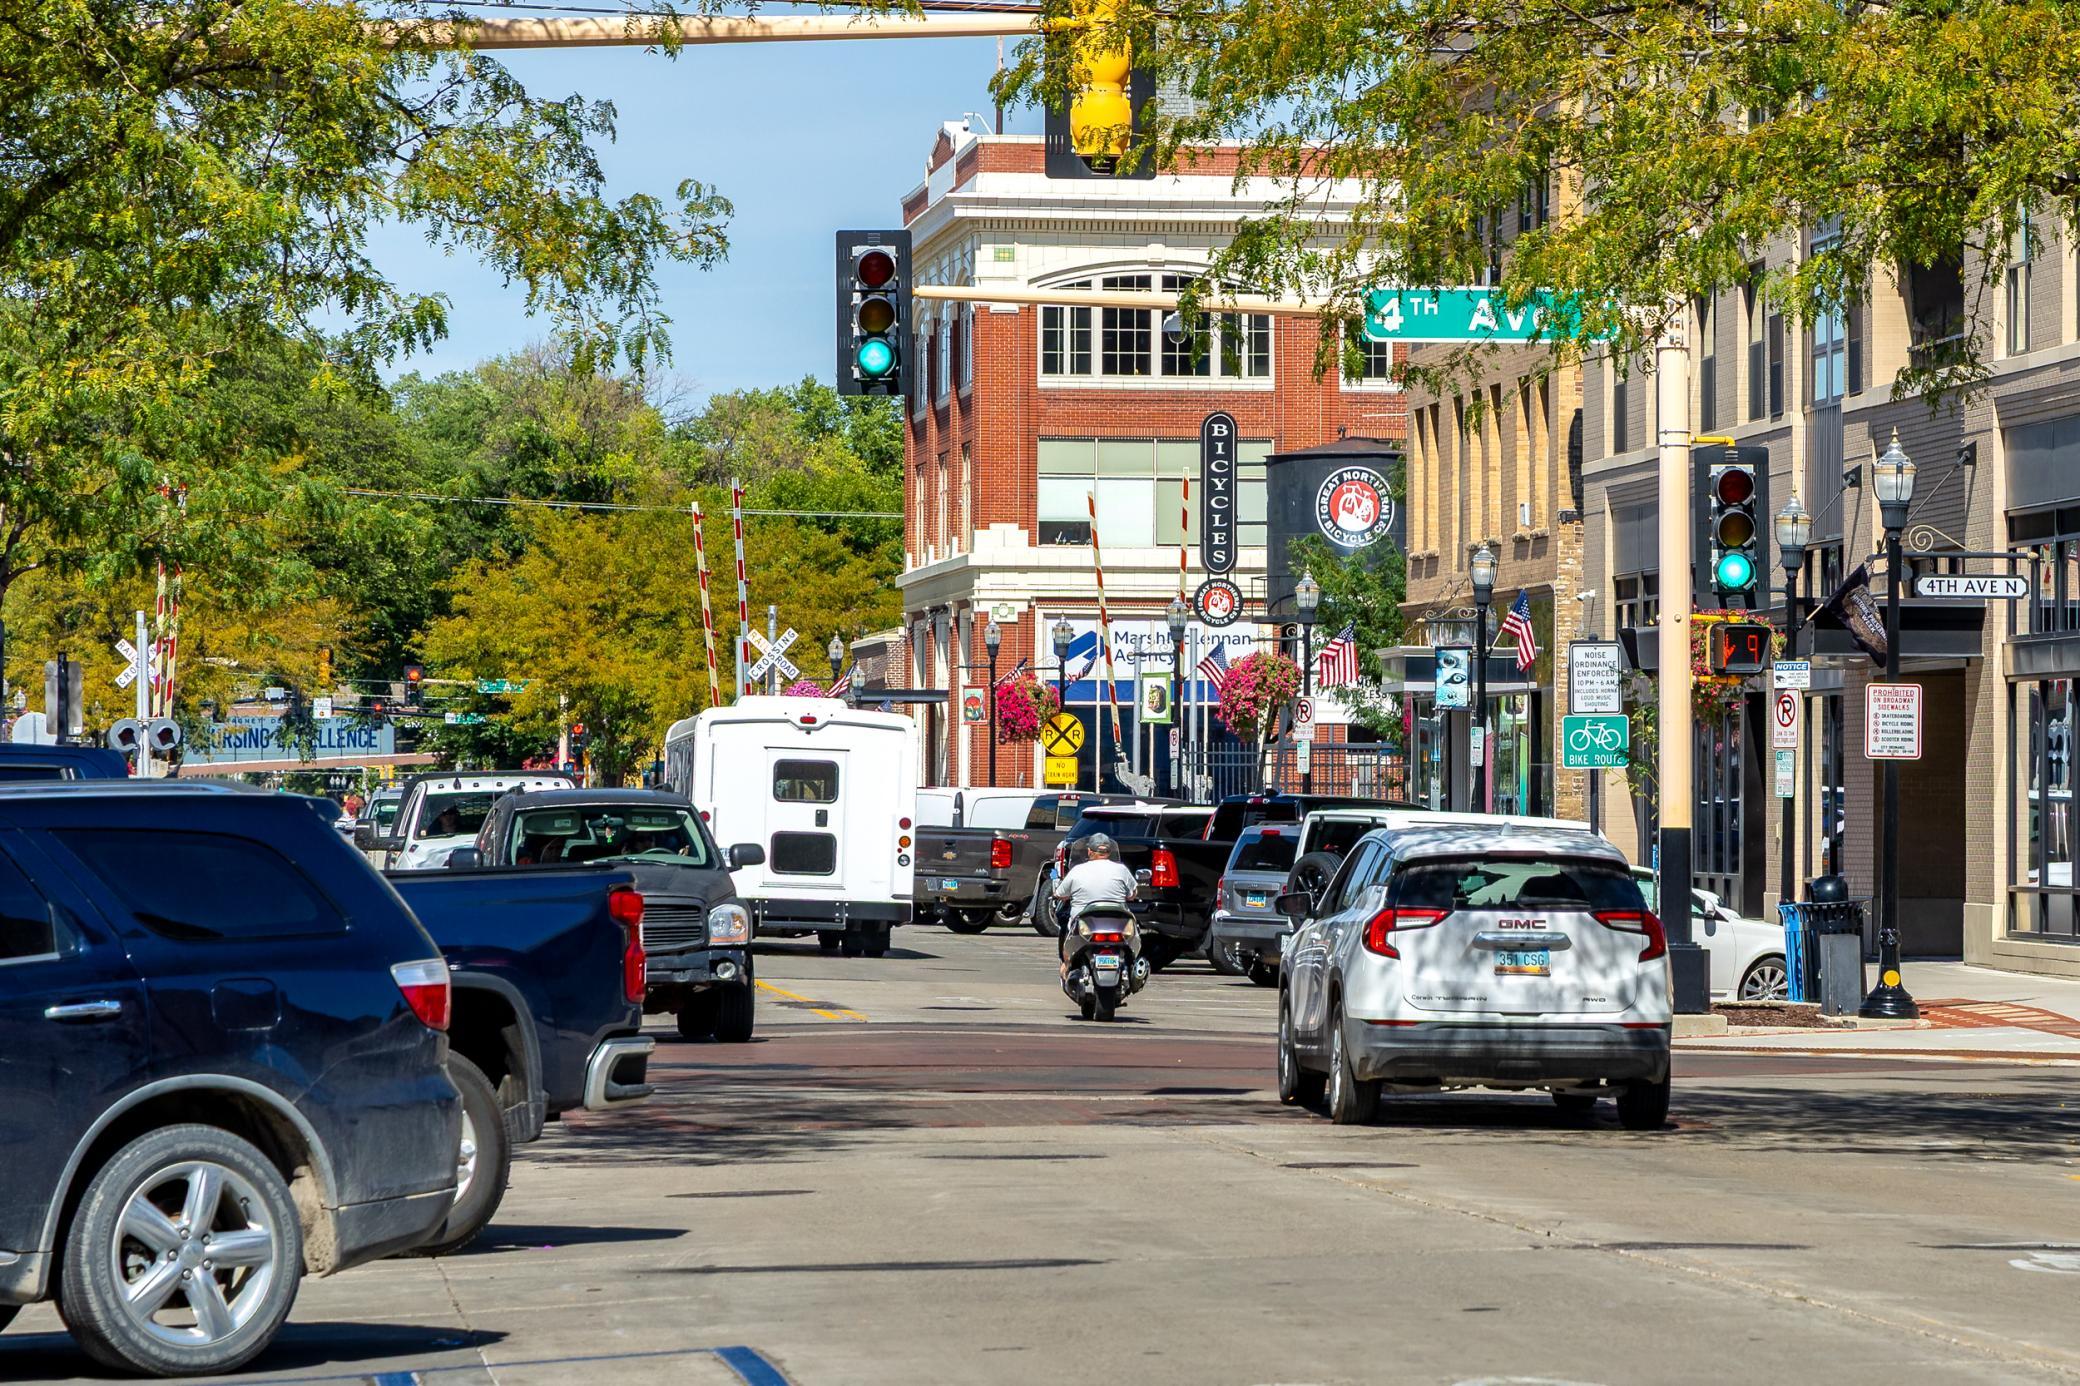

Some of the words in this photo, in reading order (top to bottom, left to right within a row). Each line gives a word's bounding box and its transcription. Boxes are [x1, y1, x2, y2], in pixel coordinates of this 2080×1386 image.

[1210, 423, 1229, 564] BICYCLES
[1320, 476, 1340, 512] GREAT
[1342, 471, 1390, 513] NORTHERN
[1324, 520, 1373, 543] BICYCLE
[1926, 579, 1958, 593] 4TH
[1964, 579, 1998, 593] AVE
[2005, 580, 2017, 593] N
[1211, 581, 1240, 607] NORTHERN
[1200, 611, 1229, 625] BICYCLE
[751, 630, 796, 677] CROSSING
[1584, 651, 1606, 659] NOISE
[774, 655, 796, 677] ROAD
[1574, 660, 1617, 668] ORDINANCE
[1776, 663, 1808, 671] NOTICE
[1577, 669, 1615, 678] ENFORCED
[1873, 689, 1915, 697] PROHIBITED
[1045, 729, 1054, 740] R
[1072, 729, 1081, 740] R
[1569, 754, 1589, 765] BIKE
[1498, 919, 1547, 929] GMC
[1499, 953, 1518, 966] 351
[1523, 953, 1545, 966] CSG
